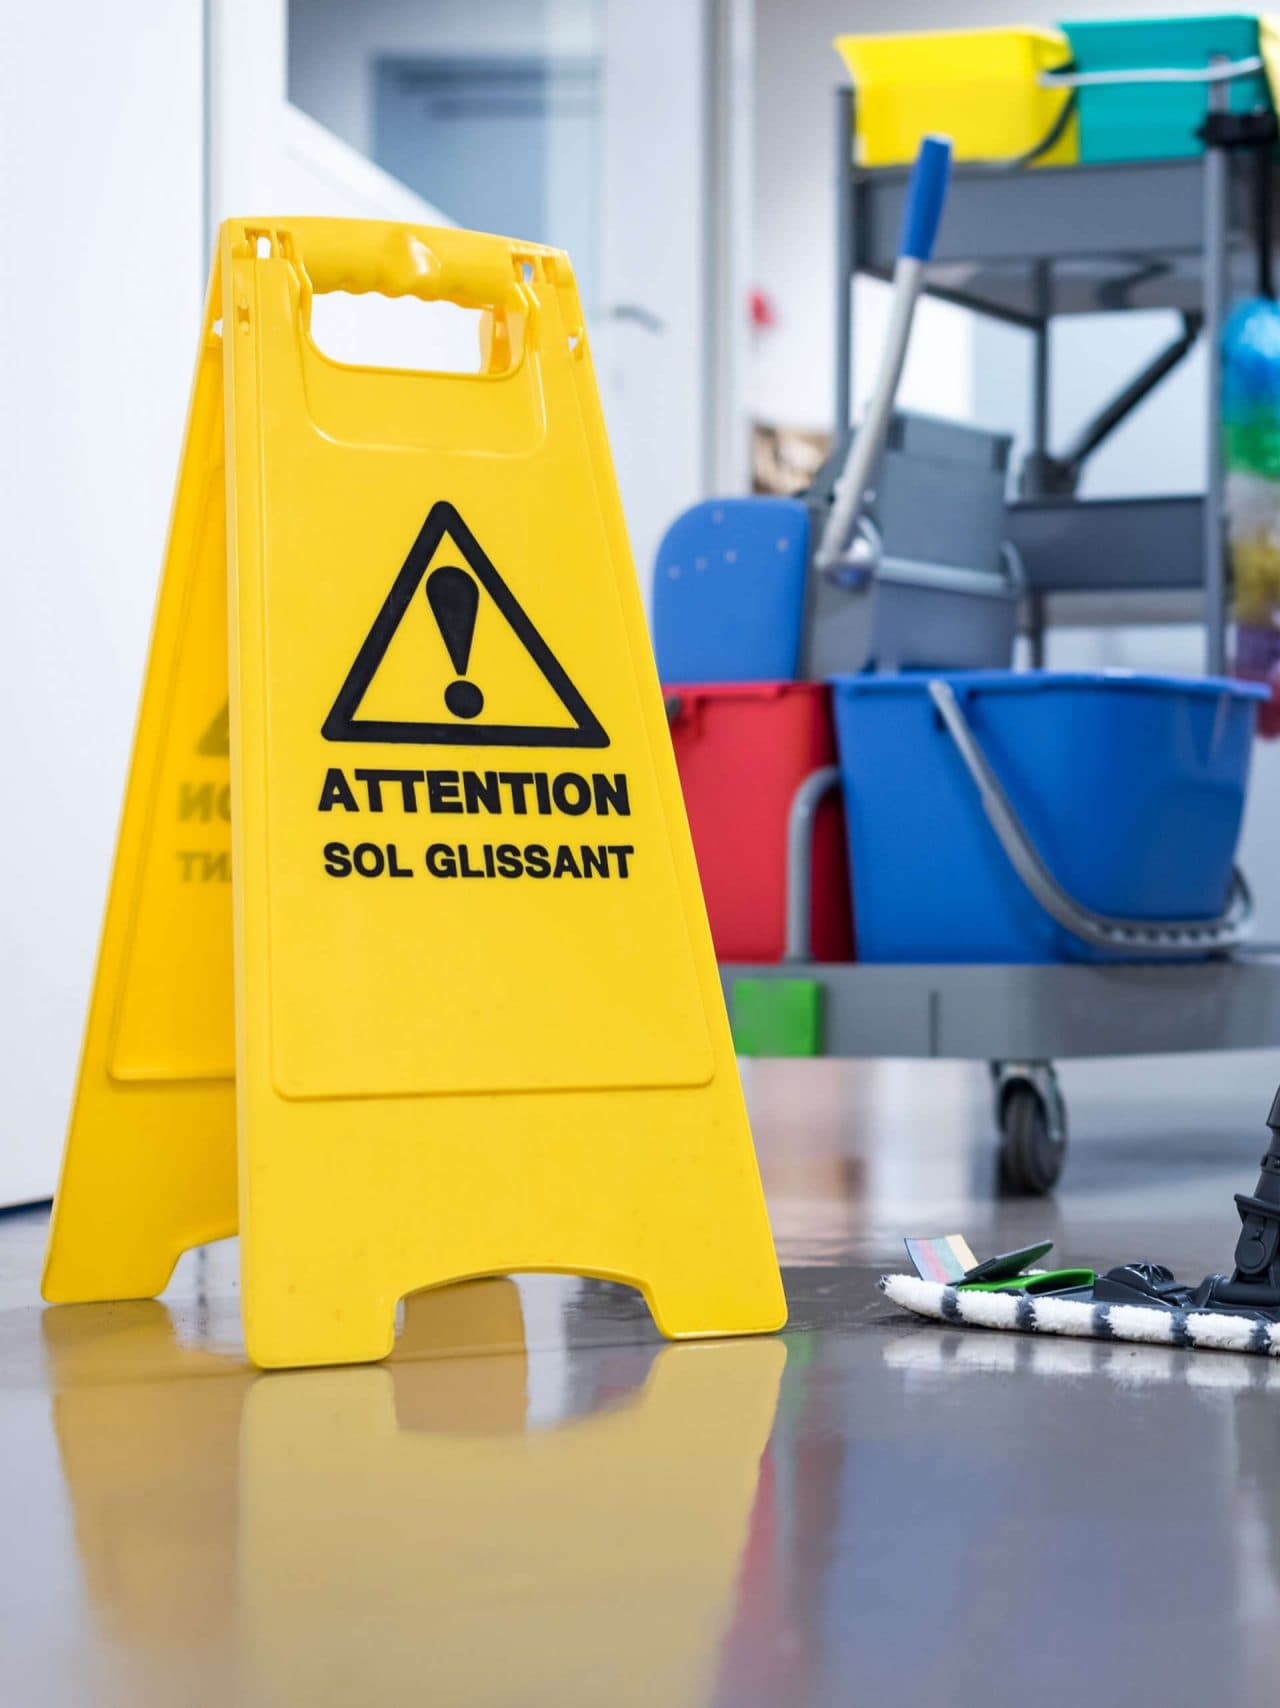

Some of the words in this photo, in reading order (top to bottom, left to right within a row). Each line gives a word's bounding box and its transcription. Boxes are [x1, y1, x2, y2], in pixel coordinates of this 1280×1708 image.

[317, 767, 631, 817] ATTENTION
[323, 841, 414, 879] SOL
[425, 843, 635, 880] GLISSANT
